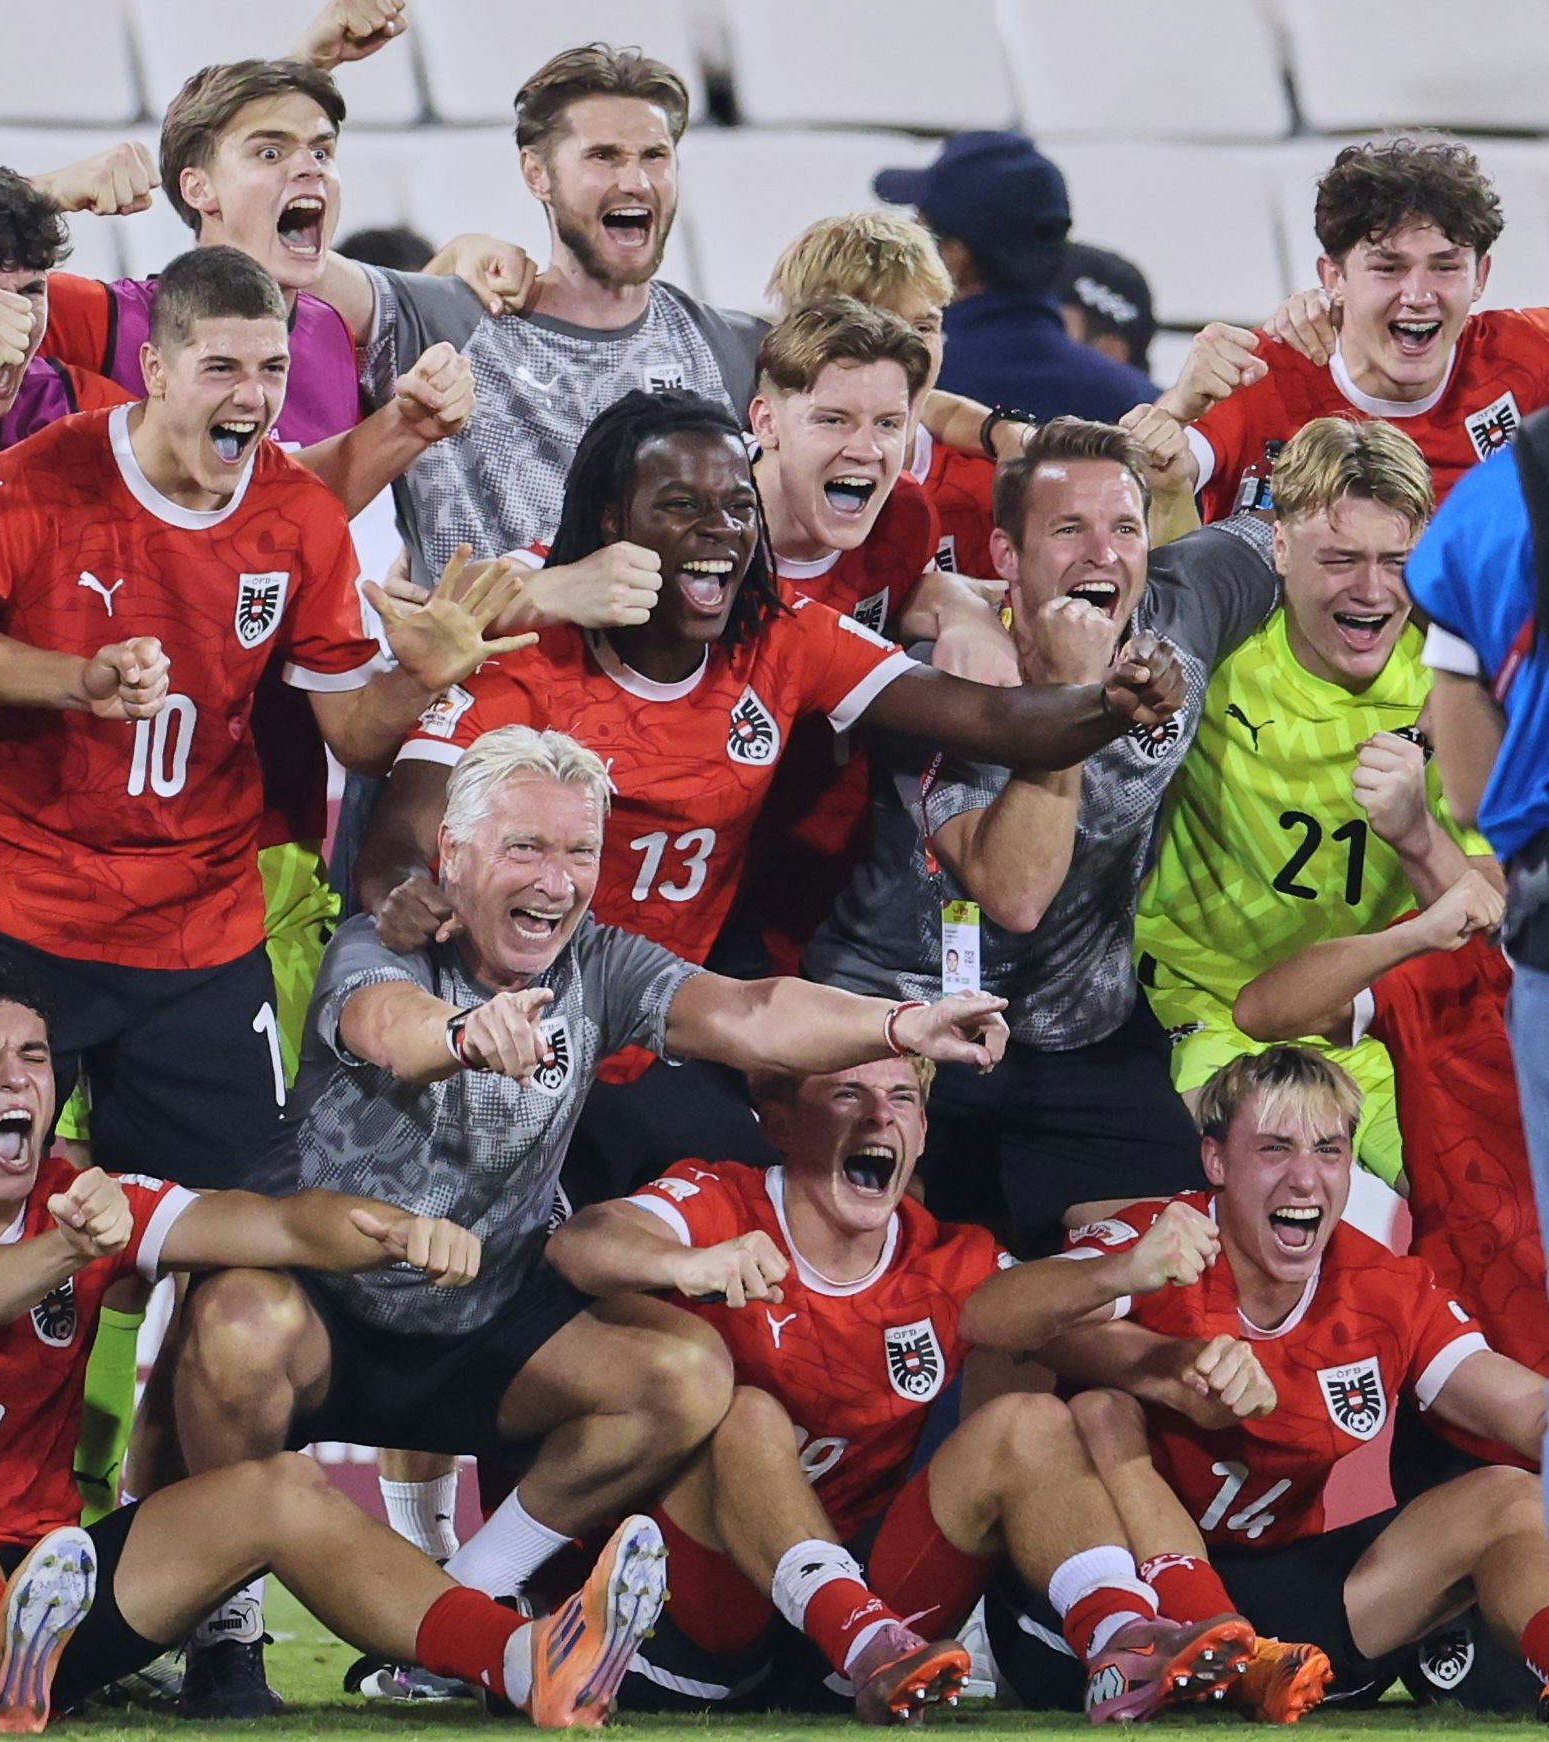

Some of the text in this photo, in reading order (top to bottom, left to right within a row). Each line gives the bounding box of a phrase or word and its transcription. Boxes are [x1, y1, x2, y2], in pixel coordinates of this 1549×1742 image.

[127, 693, 198, 797] 10
[629, 828, 717, 901] 13
[1272, 810, 1368, 906] 21
[1200, 1461, 1292, 1539] 14
